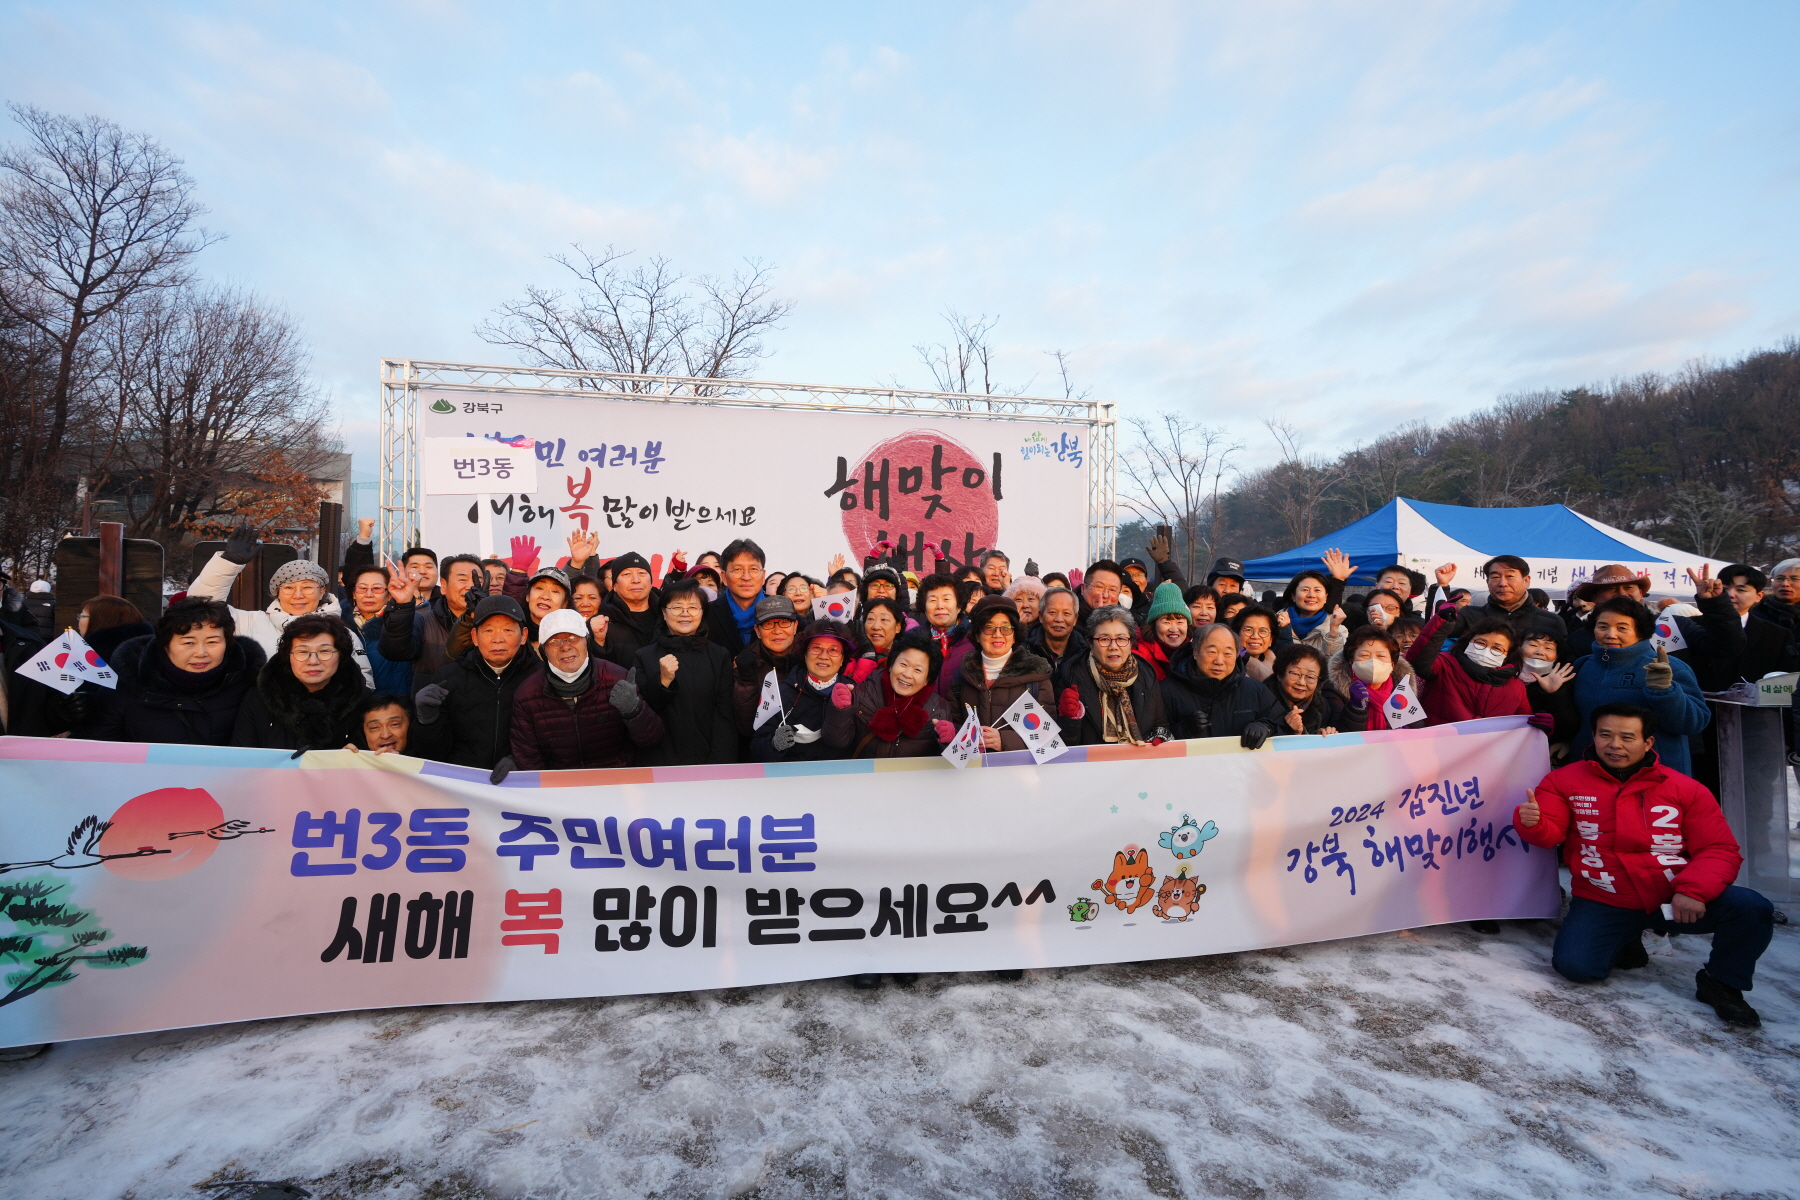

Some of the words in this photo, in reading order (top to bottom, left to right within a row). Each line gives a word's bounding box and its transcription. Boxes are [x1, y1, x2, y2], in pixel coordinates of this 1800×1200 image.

[462, 402, 504, 414] 강북구
[453, 457, 514, 479] 번3동
[578, 440, 666, 474] 여러분
[1050, 432, 1083, 468] 강북
[559, 466, 594, 531] 복
[602, 495, 658, 528] 많이
[665, 496, 756, 531] 받으세요
[824, 444, 1003, 521] 해맞이
[1537, 566, 1558, 584] 기념
[1329, 800, 1386, 828] 2024
[1398, 776, 1485, 820] 갑진년
[290, 808, 470, 878] 번3동
[496, 811, 818, 873] 주민여러분
[1286, 832, 1356, 896] 강북
[320, 889, 474, 964] 새해
[500, 888, 564, 955] 복
[592, 885, 718, 953] 많이
